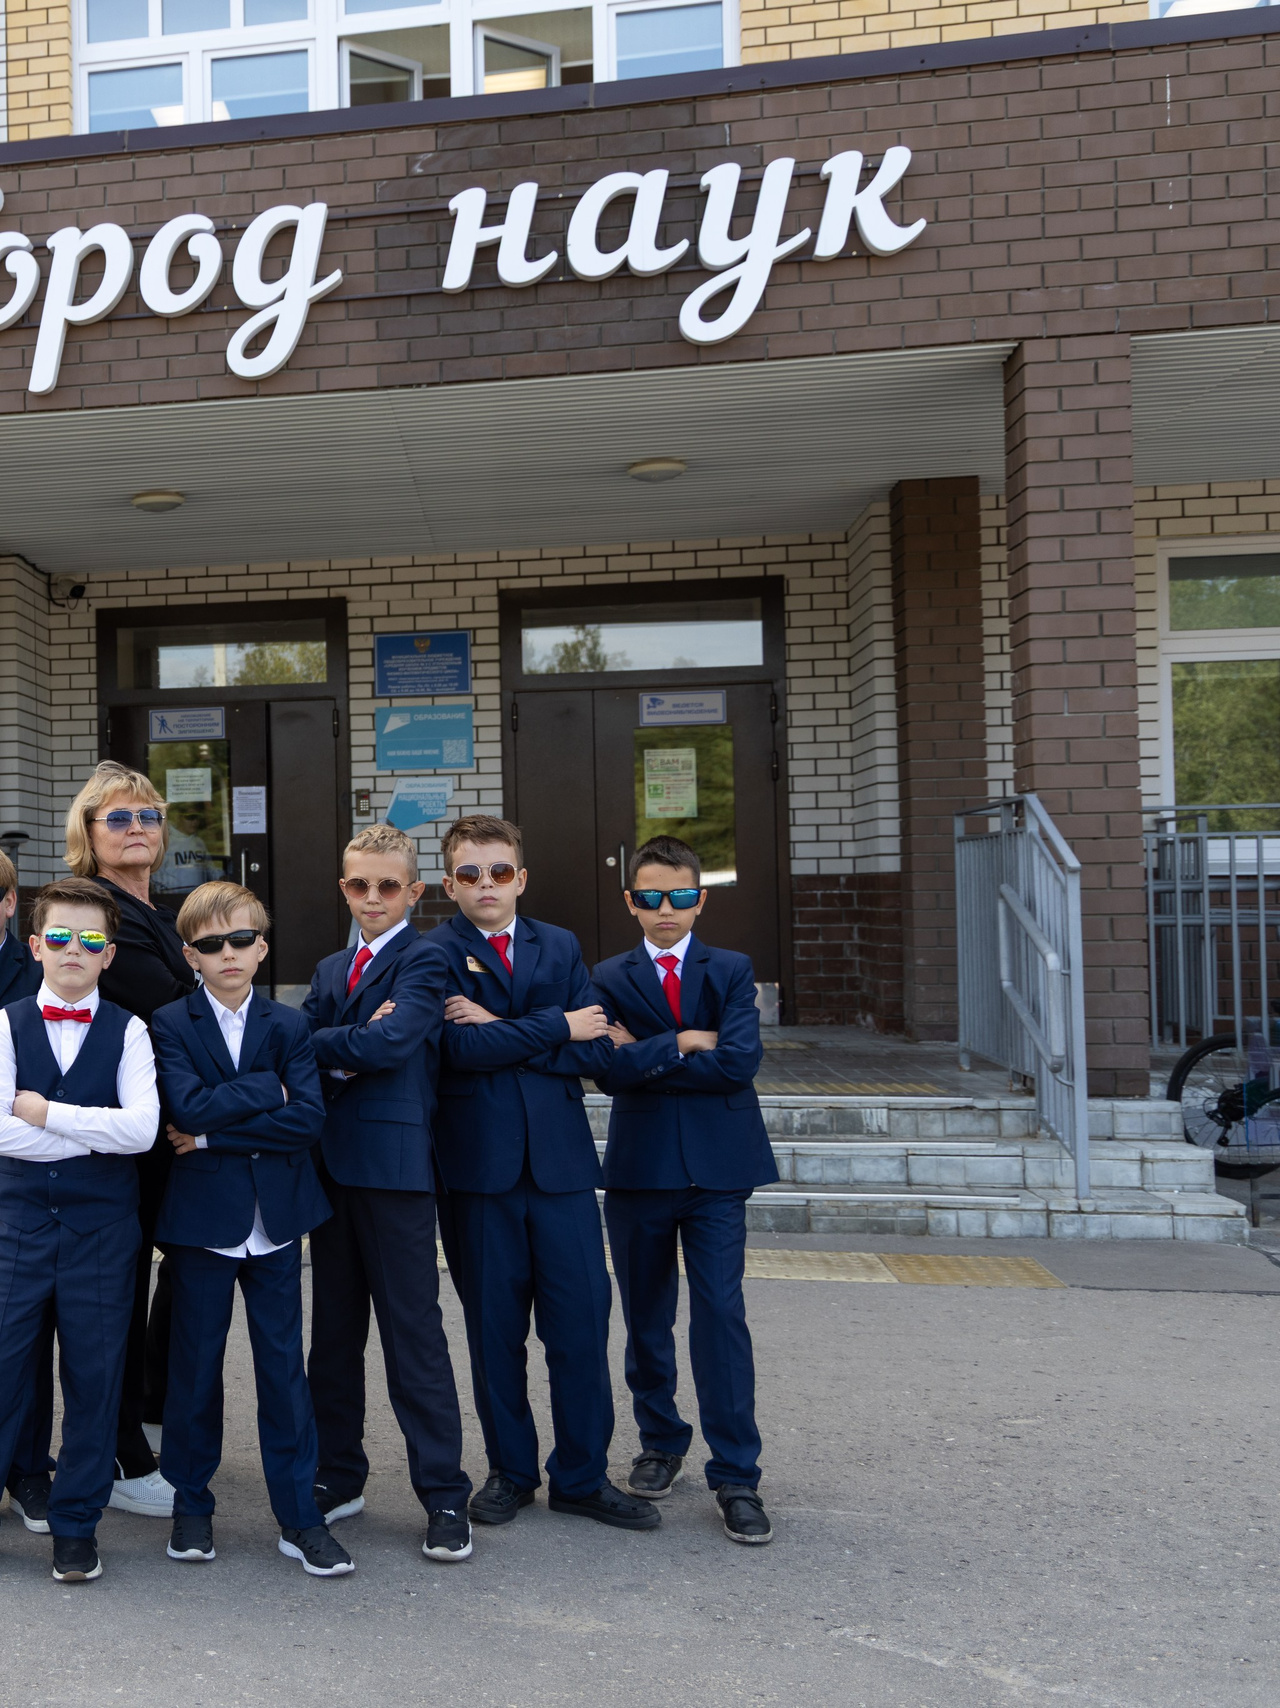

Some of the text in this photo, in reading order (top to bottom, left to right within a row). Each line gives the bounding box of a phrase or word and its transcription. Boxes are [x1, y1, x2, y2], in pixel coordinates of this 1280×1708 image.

[440, 144, 928, 347] наук
[413, 712, 466, 721] ОБРАЗОВАНИЕ
[646, 708, 718, 716] ВИДЕОНАБЛЮДЕНИЕ
[174, 850, 206, 865] NAS
